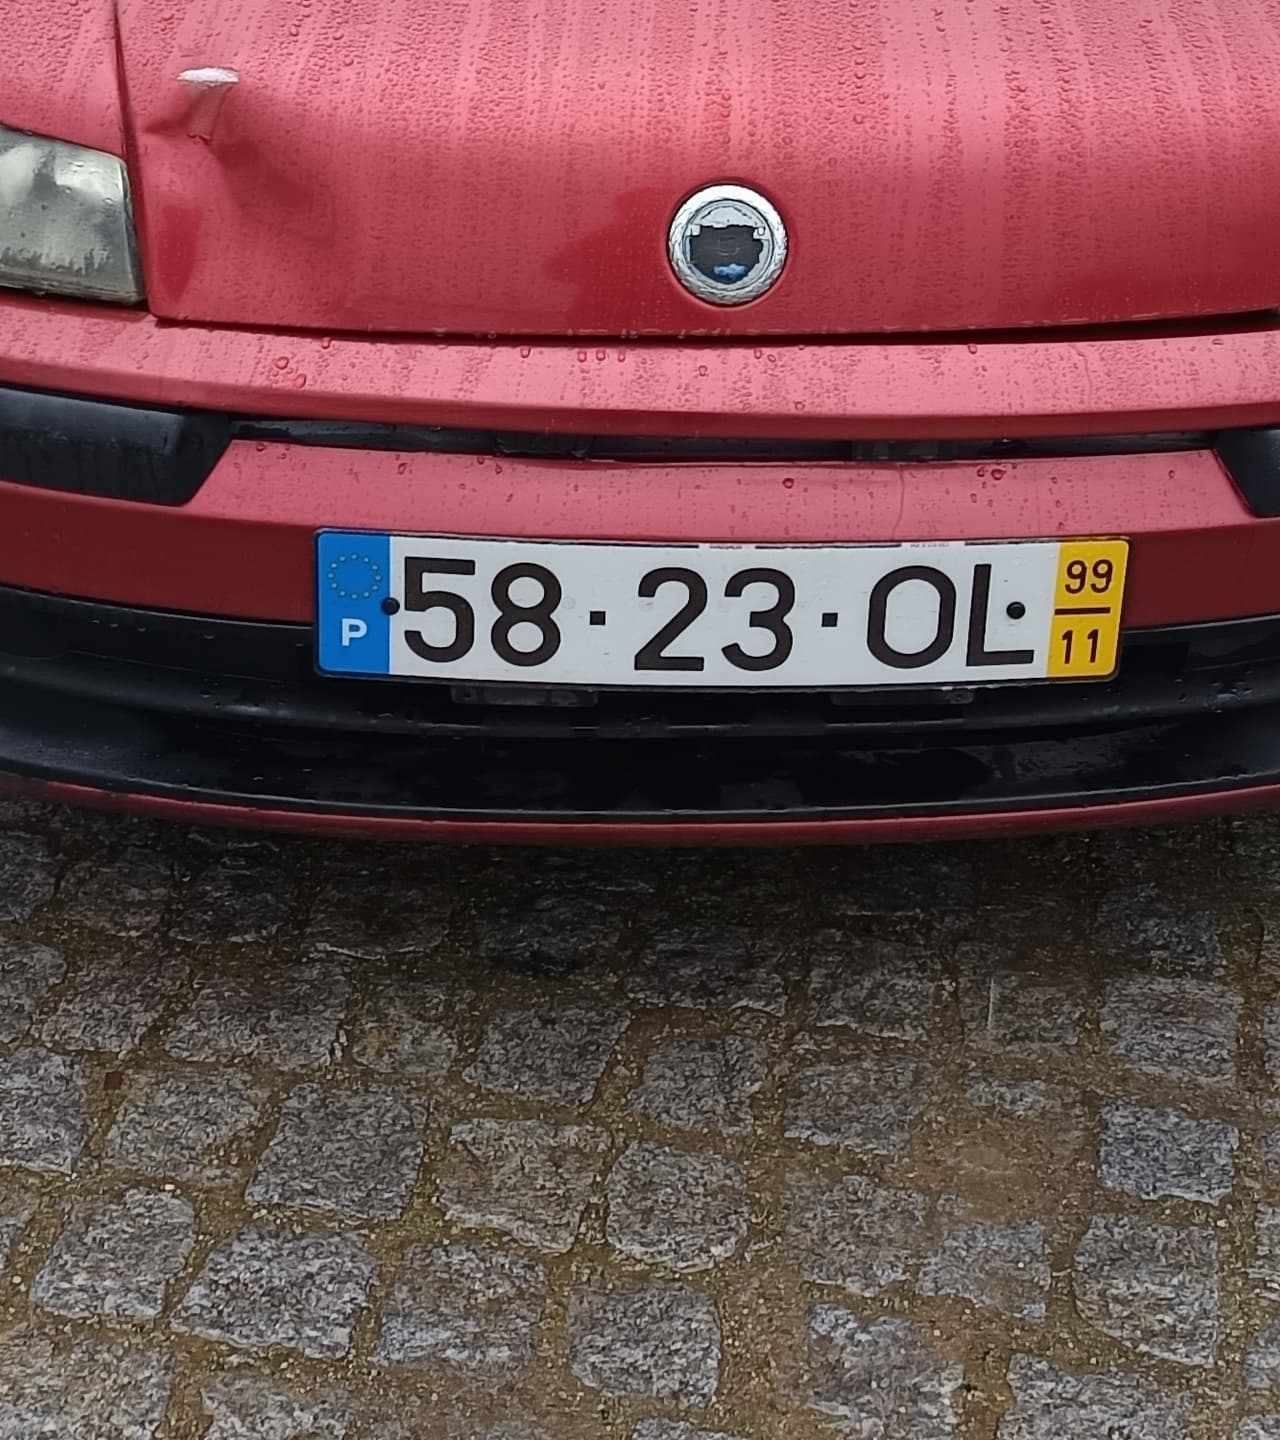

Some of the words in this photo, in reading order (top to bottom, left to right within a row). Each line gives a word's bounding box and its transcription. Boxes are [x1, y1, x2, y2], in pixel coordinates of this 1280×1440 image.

[1064, 559, 1114, 595] 99
[339, 617, 368, 647] P
[1060, 629, 1101, 666] 11
